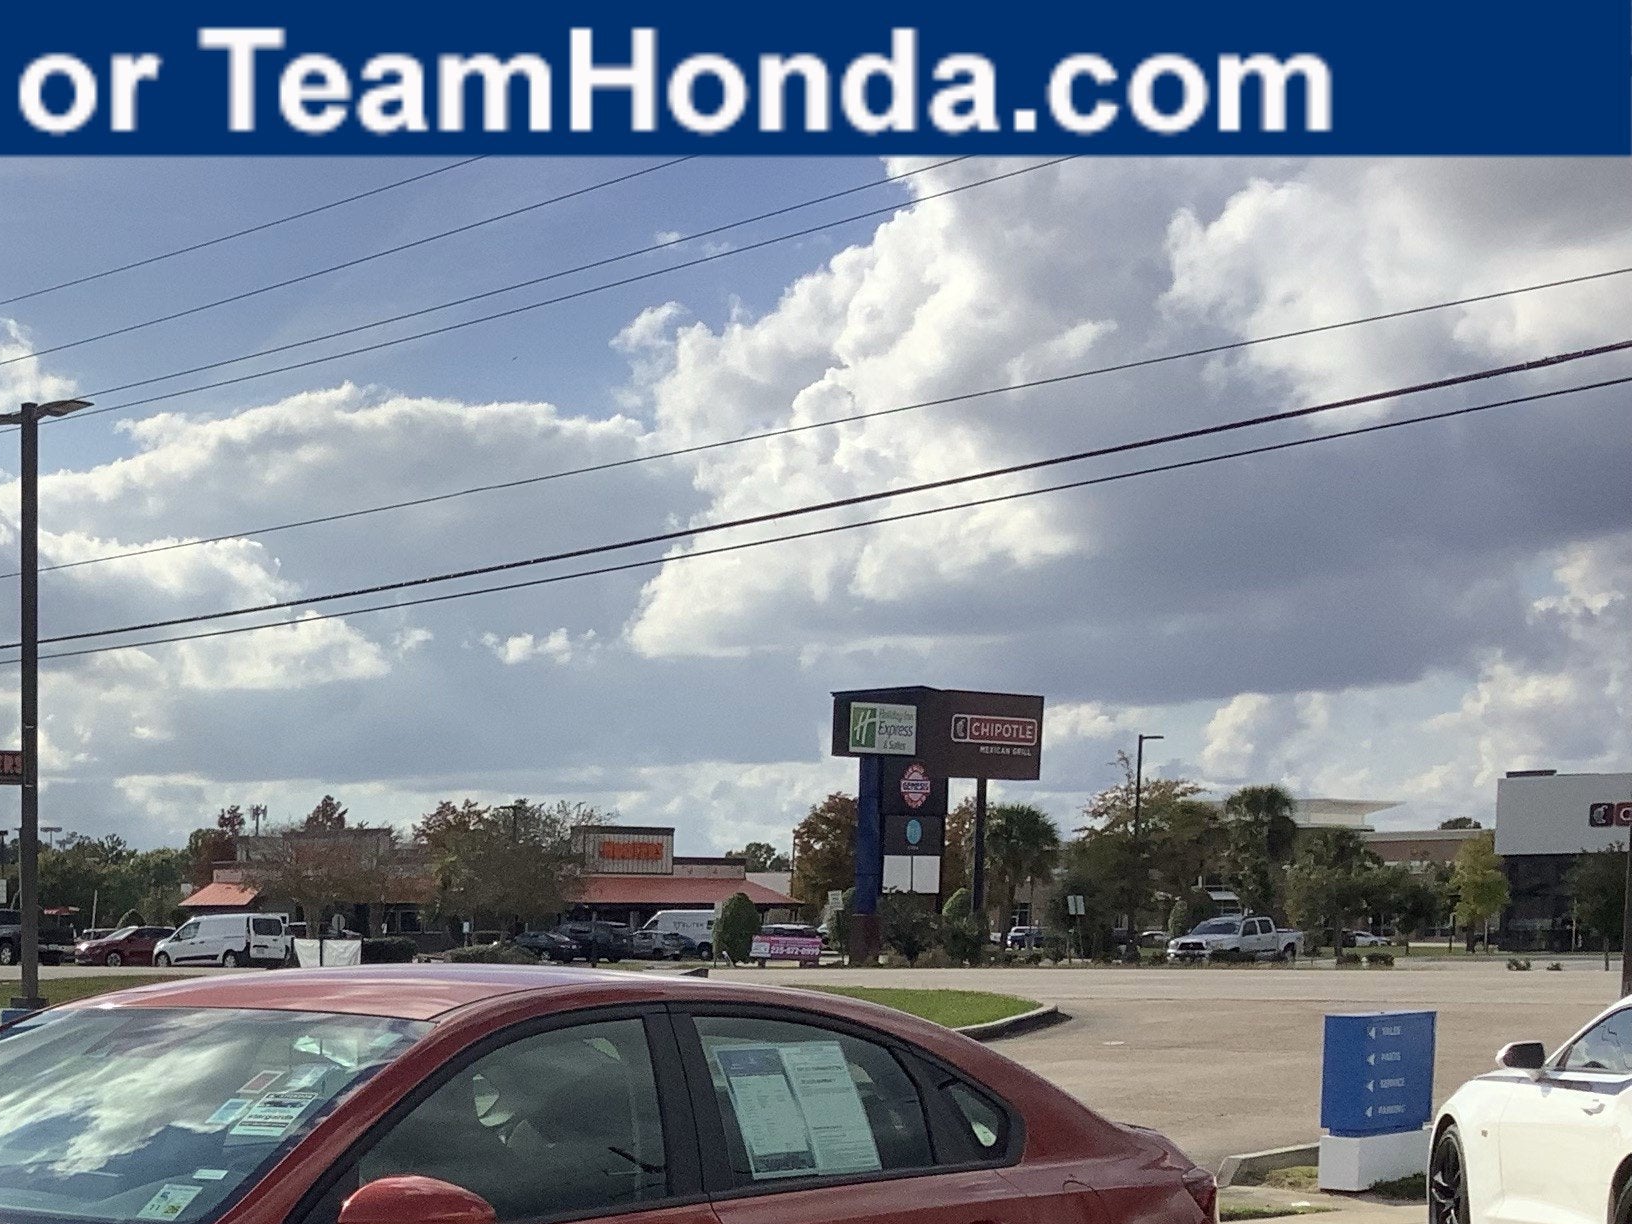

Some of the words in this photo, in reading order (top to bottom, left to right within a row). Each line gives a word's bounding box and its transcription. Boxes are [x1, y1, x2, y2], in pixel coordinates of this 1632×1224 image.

[878, 722, 914, 739] Express
[971, 722, 1033, 739] CHIPOTLE
[979, 746, 1010, 755] MEXICAN
